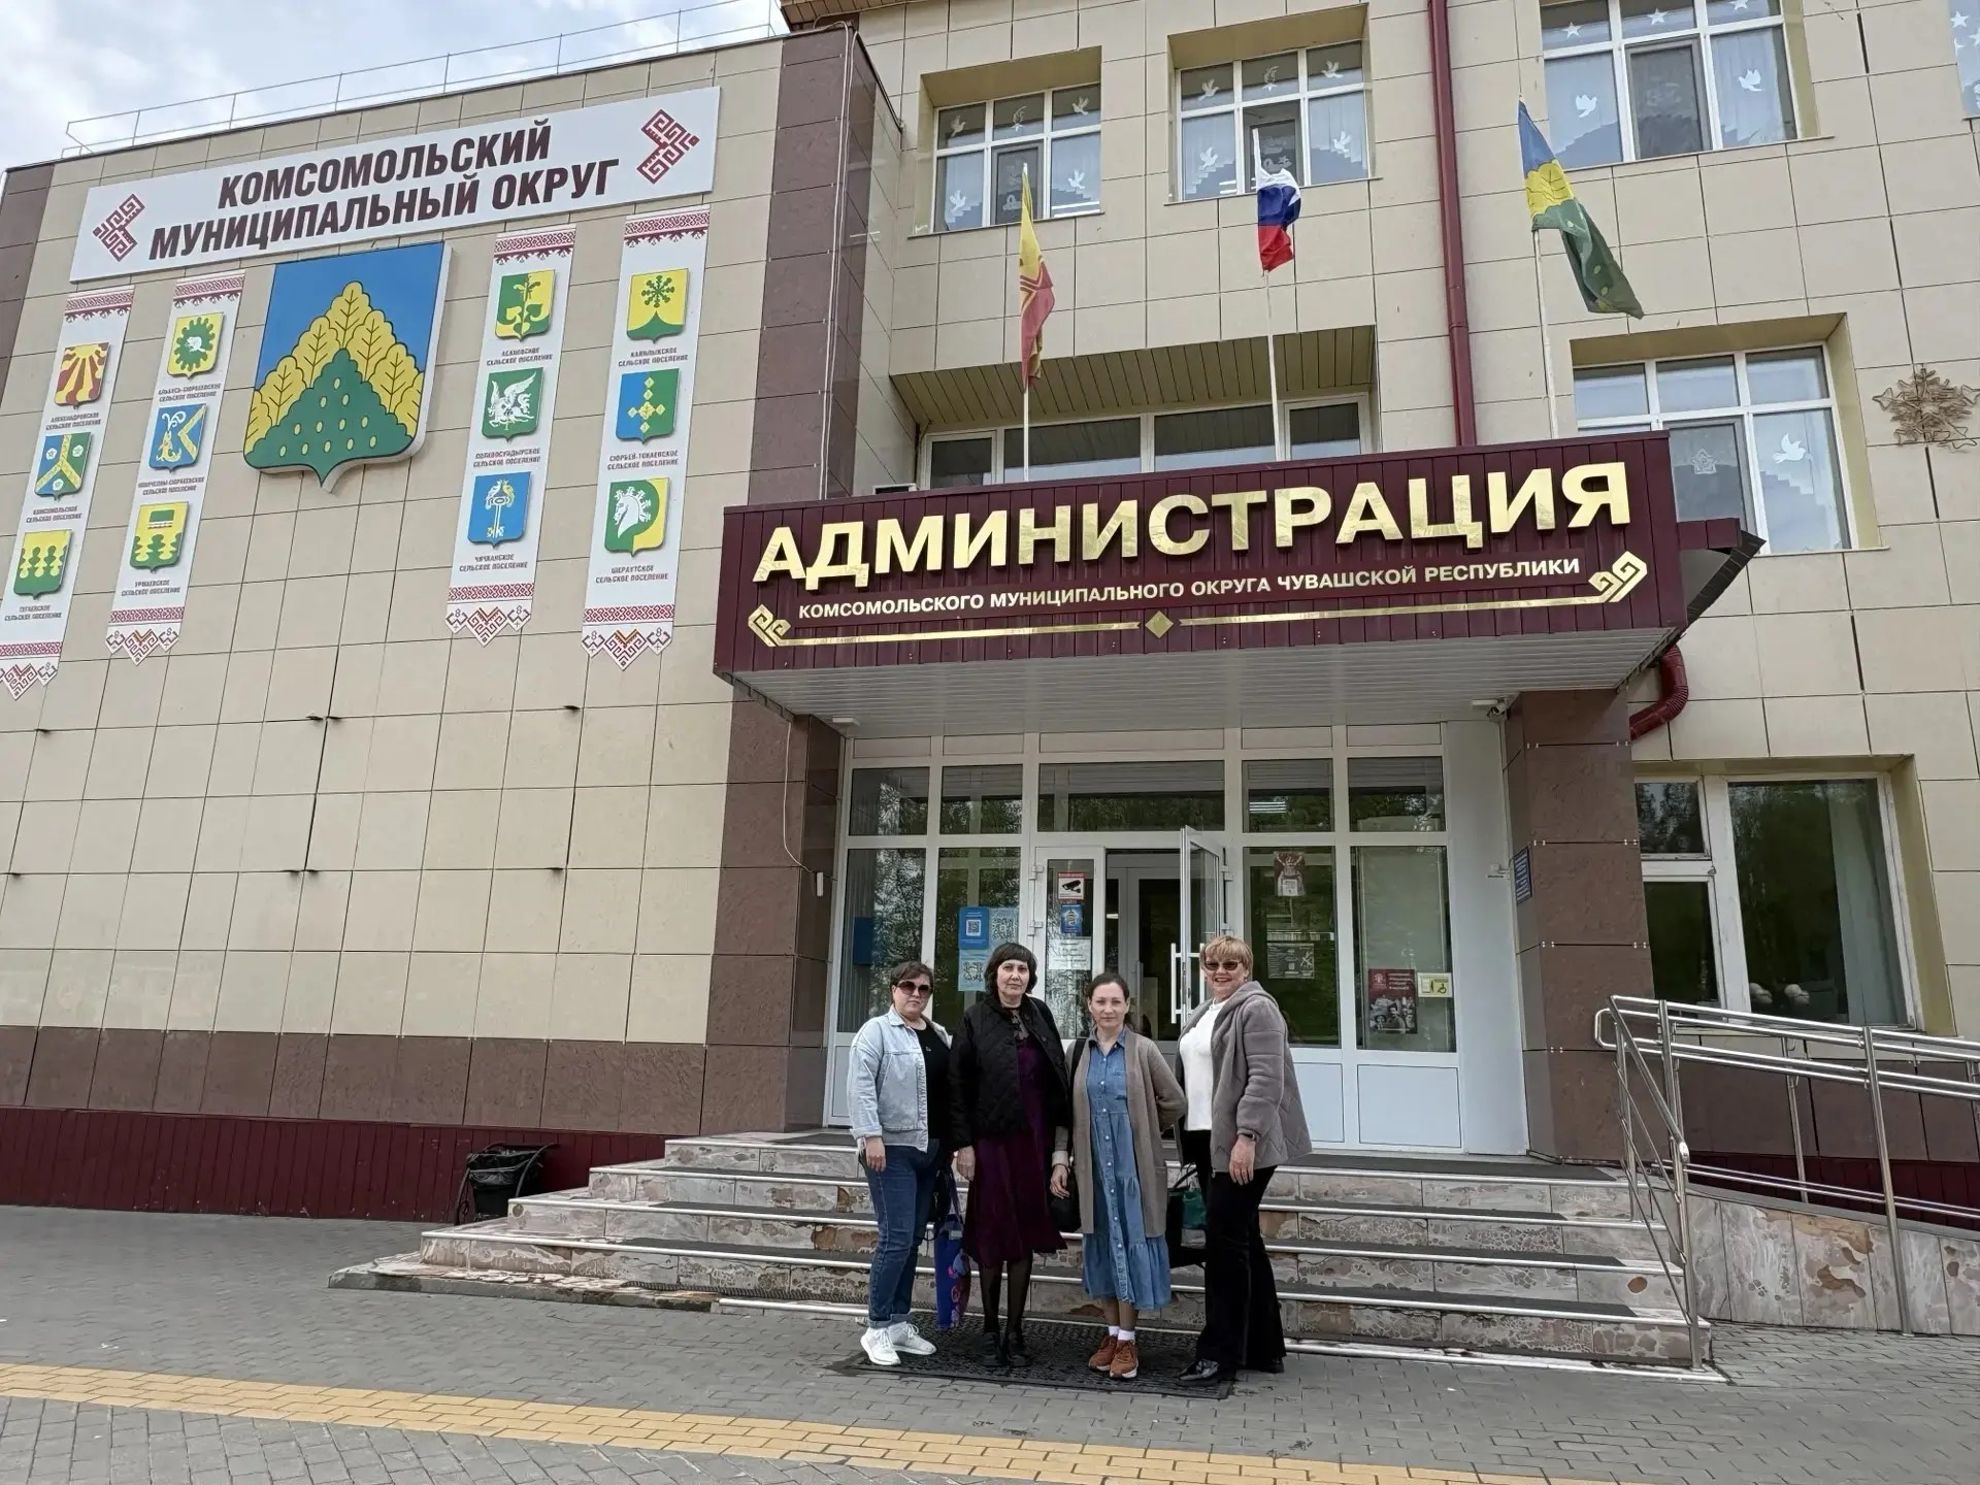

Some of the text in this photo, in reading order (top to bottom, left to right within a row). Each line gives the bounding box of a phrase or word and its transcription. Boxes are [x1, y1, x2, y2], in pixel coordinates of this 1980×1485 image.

[217, 117, 552, 208] КОМСОМОЛЬСКИЙ
[150, 159, 620, 260] МУНИЦИПАЛЬНЫЙ ОКРУГ
[618, 354, 688, 367] СЕЛЬСКОЕ ПОСЕЛЕНИЕ
[473, 456, 541, 468] СЕЛЬСКОЕ ПОСЕЛЕНИЕ
[607, 458, 679, 470] СЕЛЬСКОЕ ПОСЕЛЕНИЕ
[752, 461, 1631, 591] АДМИНИСТРАЦИЯ
[459, 561, 528, 572] СЕЛЬСКОЕ ПОСЕЛЕНИЕ
[595, 573, 668, 583] СЕЛЬСКОЕ ПОСЕЛЕНИЕ
[799, 559, 1580, 620] КОМСОМОЛЬСКОГО МУНИЦИПАЛЬНОГО ОКРУГА ЧУВАШСКОЙ РЕСПУБЛИКИ
